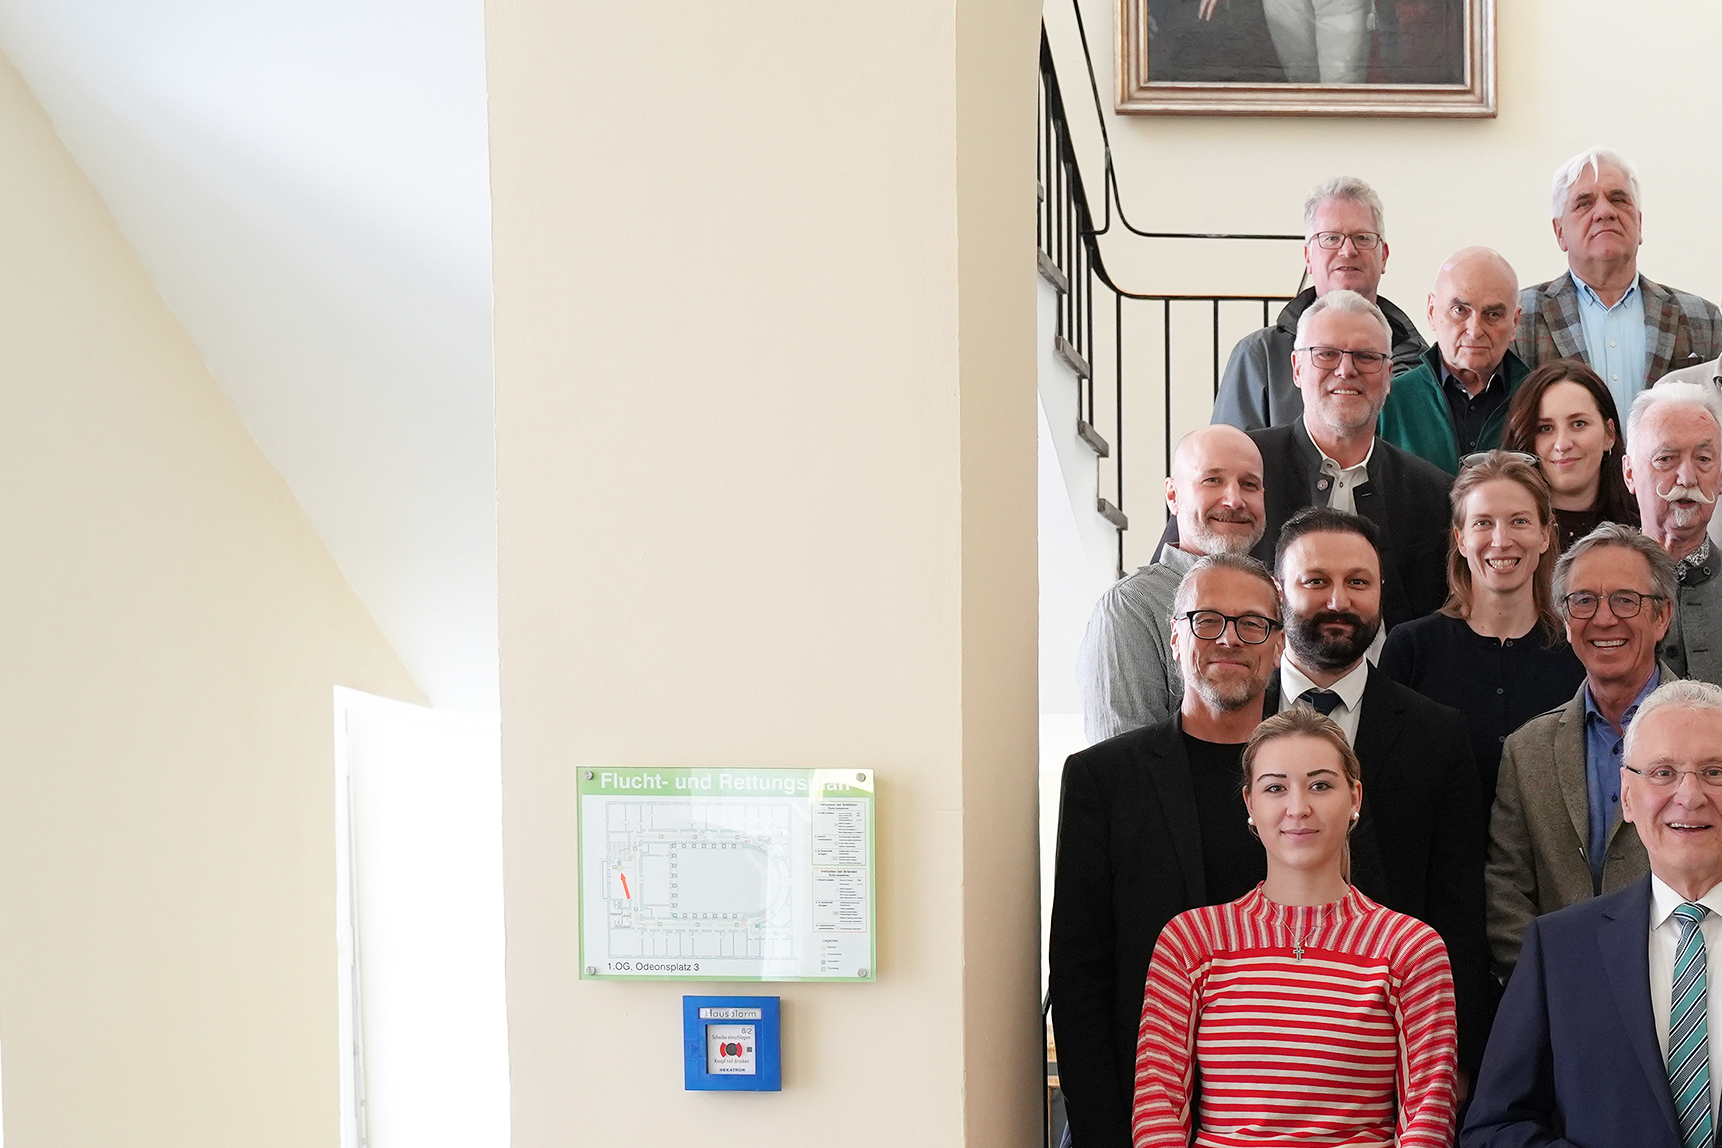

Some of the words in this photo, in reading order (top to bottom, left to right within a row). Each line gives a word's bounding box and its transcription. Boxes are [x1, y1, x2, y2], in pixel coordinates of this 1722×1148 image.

[601, 772, 669, 790] Flucht-
[675, 773, 712, 790] und
[635, 961, 692, 973] Odeonsplatz
[693, 962, 700, 972] 3
[705, 1009, 756, 1017] Hausalarm
